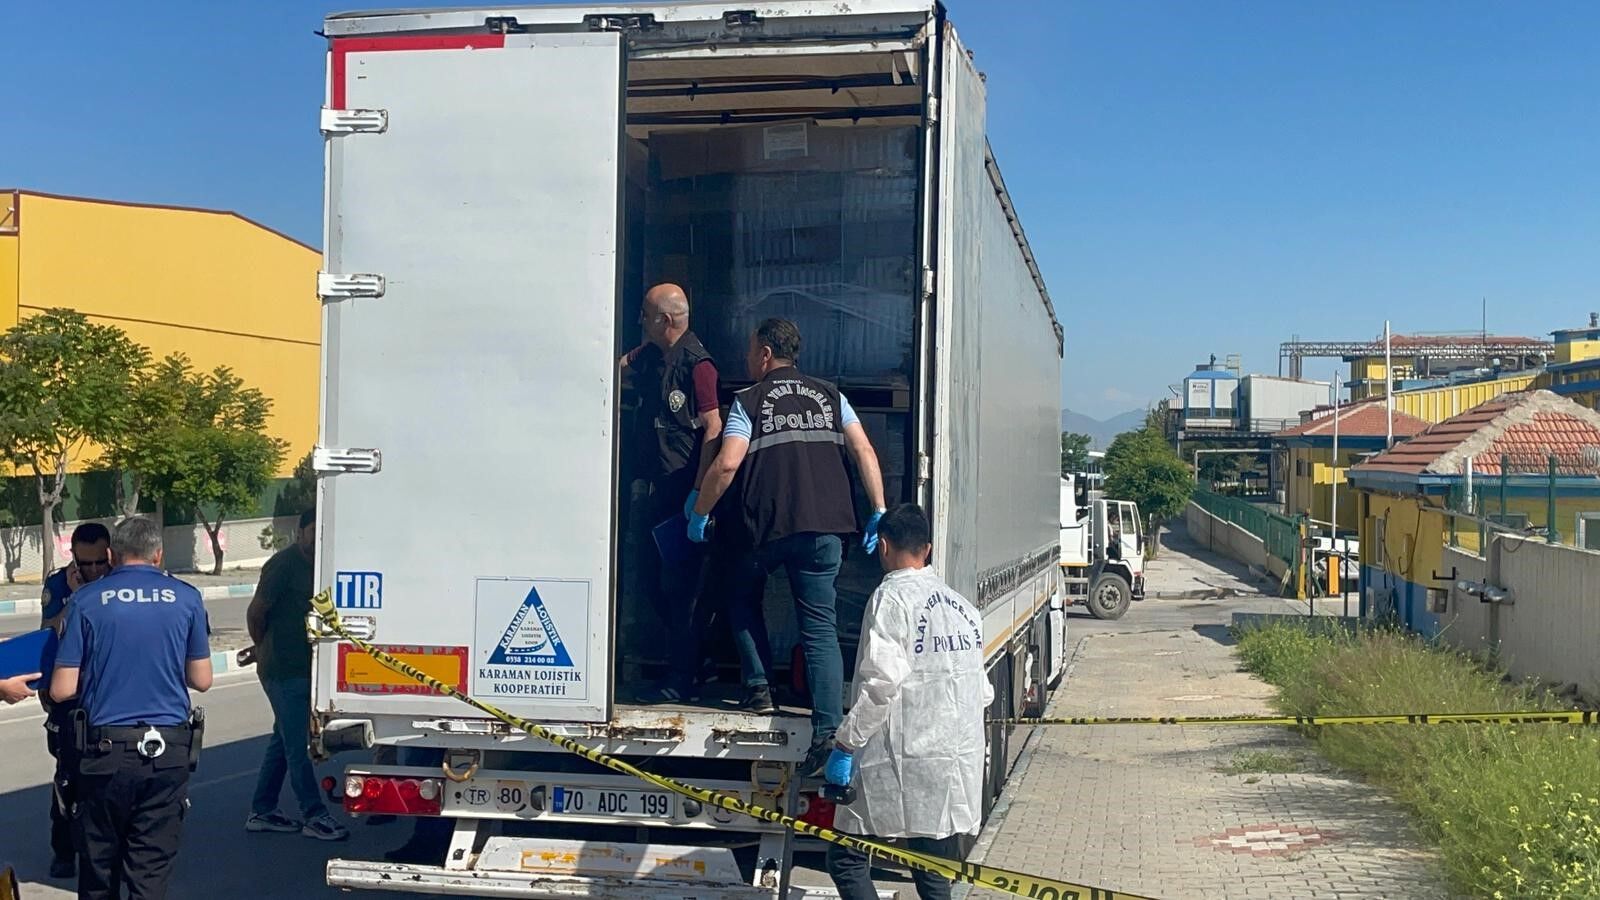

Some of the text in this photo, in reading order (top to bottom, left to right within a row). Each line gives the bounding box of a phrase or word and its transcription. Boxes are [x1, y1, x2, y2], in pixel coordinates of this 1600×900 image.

[762, 400, 775, 433] OLAY
[774, 410, 825, 431] POLİS
[338, 574, 380, 608] TIR
[499, 604, 529, 650] KARAMAN
[914, 615, 928, 654] OLAY
[524, 656, 536, 664] 214
[537, 656, 545, 664] 00
[479, 668, 582, 682] KARAMAN LOJİSTİK
[493, 682, 566, 696] KOOPERATİFİ
[469, 788, 487, 802] TR
[500, 787, 522, 804] 80
[563, 790, 668, 815] 70 ADC 199
